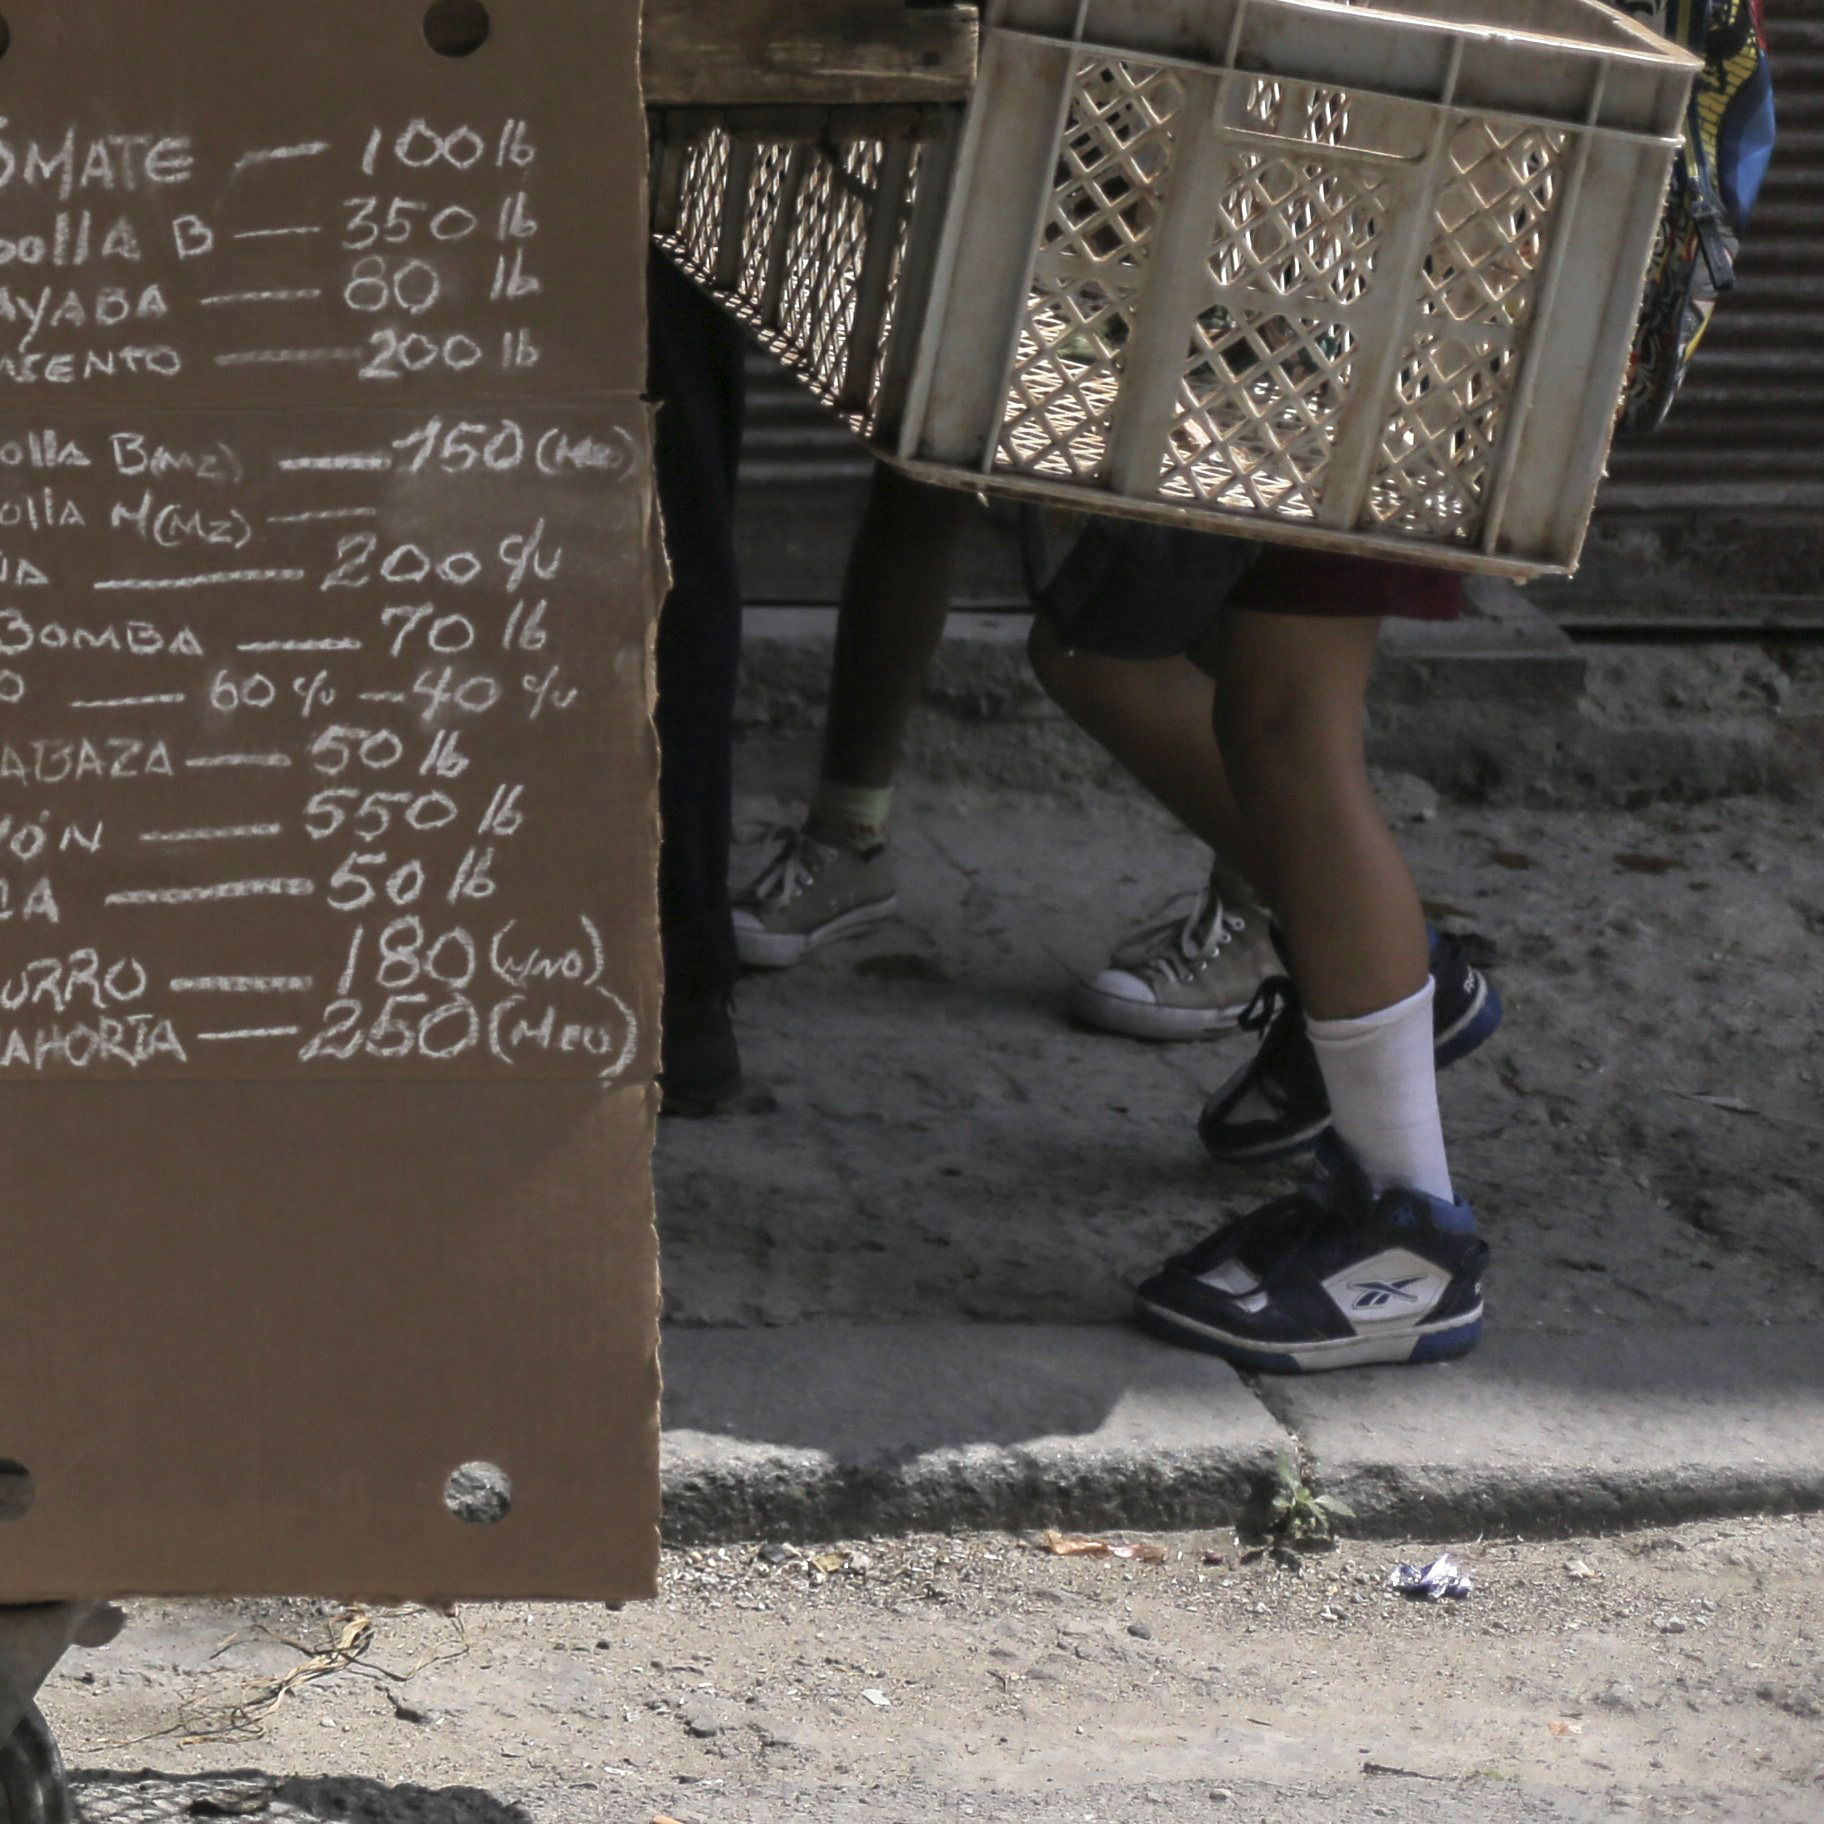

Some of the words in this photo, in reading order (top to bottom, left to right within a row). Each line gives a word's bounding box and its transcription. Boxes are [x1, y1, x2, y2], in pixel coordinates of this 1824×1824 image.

[362, 119, 484, 175] 100
[496, 119, 535, 166] lb
[172, 214, 214, 260] B
[342, 197, 478, 250] 350
[499, 191, 538, 240] lb
[344, 255, 440, 314] 80
[490, 246, 540, 302] lb
[358, 328, 481, 379] 200
[502, 329, 539, 368] lb
[392, 415, 524, 473] 150
[320, 532, 481, 591] 200
[381, 602, 474, 656] 70
[210, 668, 275, 711] 60
[414, 666, 498, 721] 40
[311, 725, 402, 775] 50
[419, 730, 470, 777] lb
[304, 786, 458, 841] 550
[327, 852, 425, 910] 50
[337, 915, 475, 995] 180
[298, 993, 479, 1061] 250
